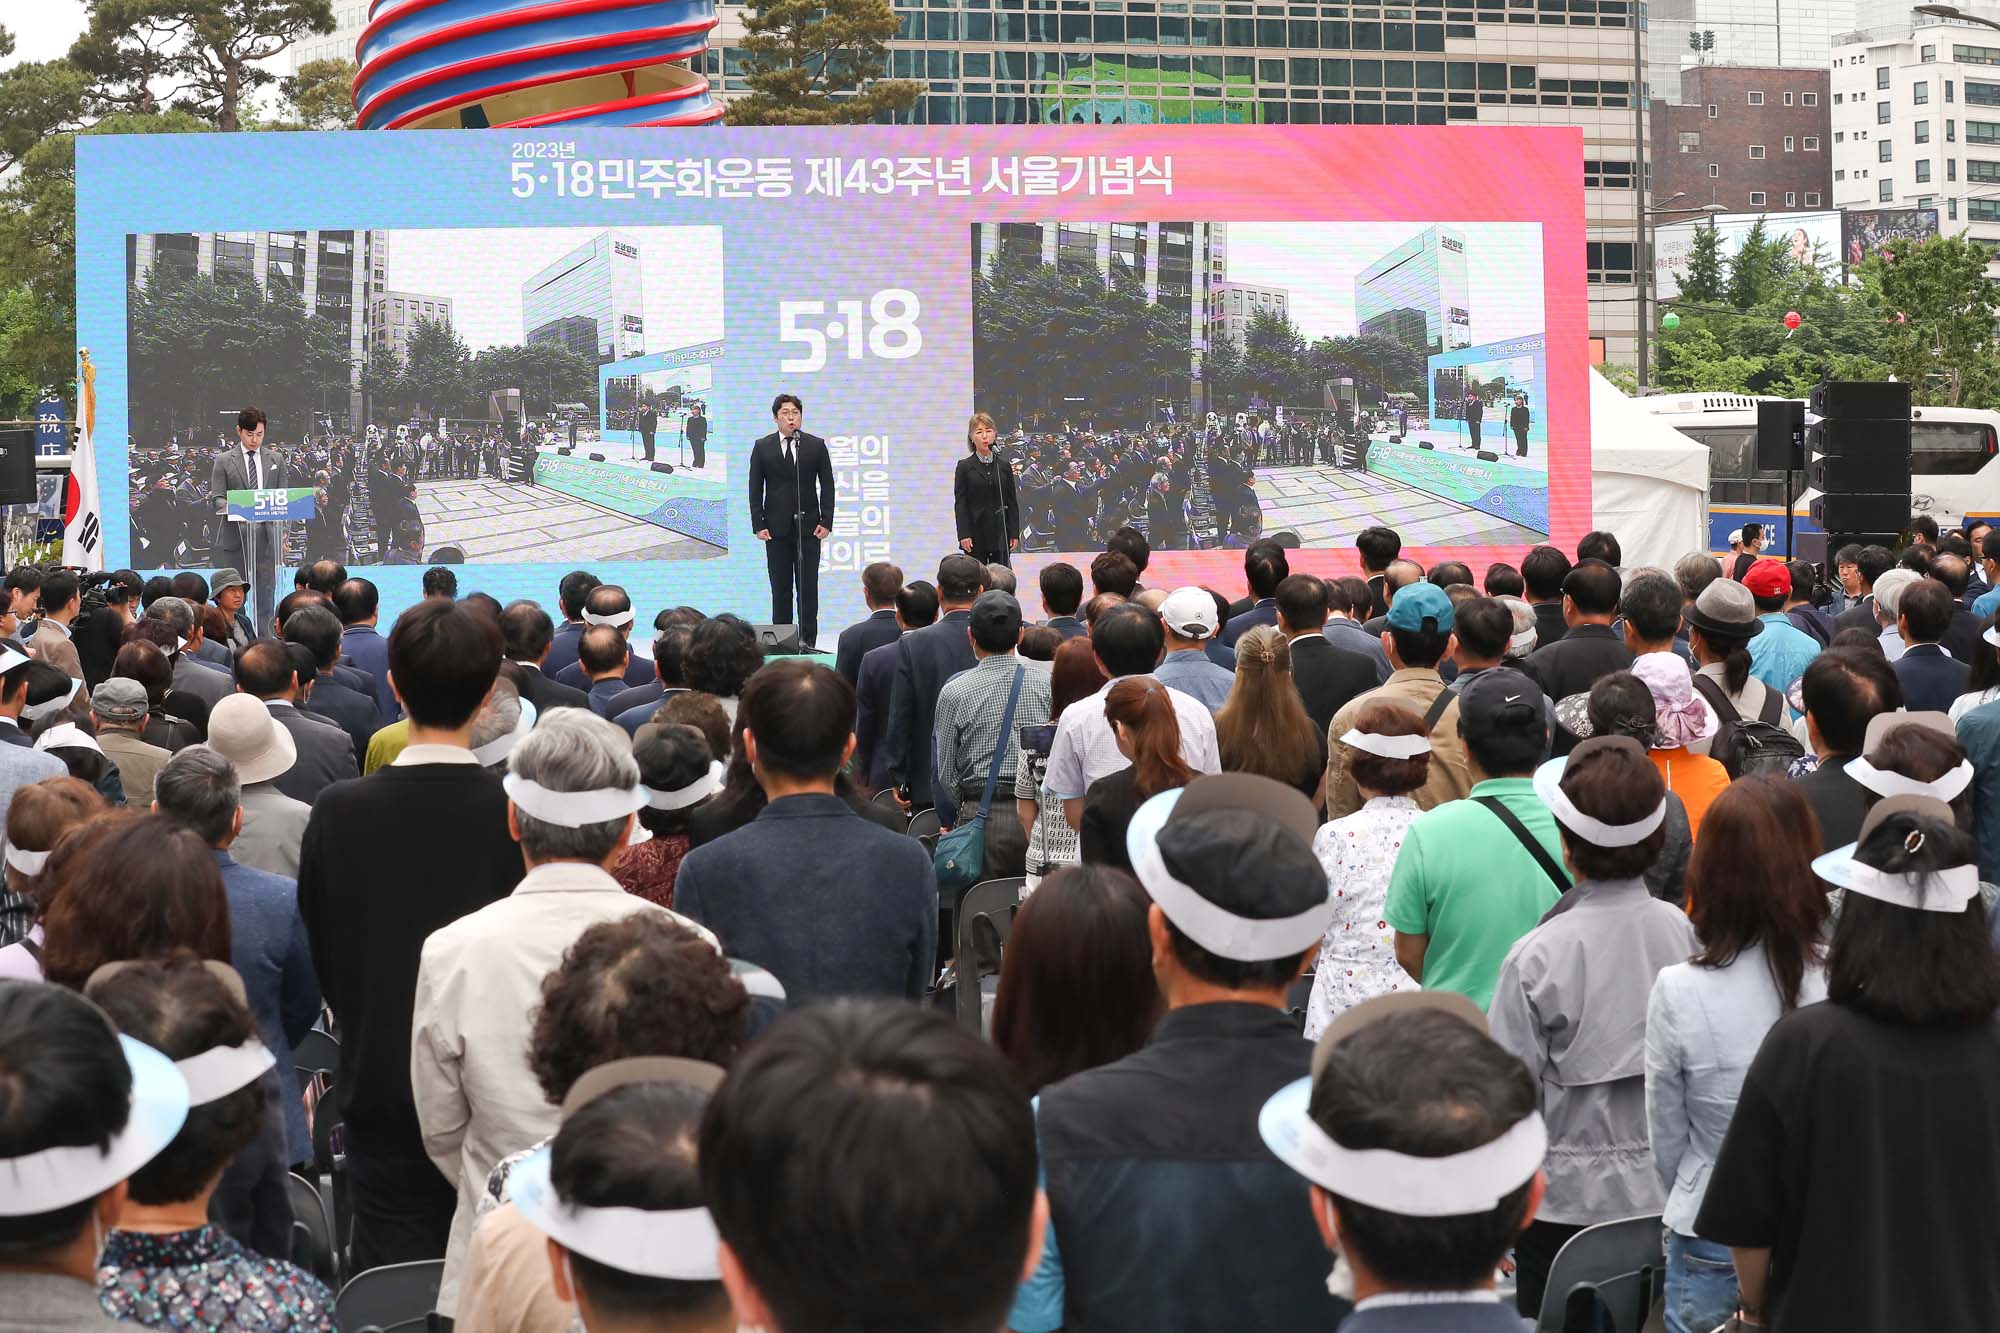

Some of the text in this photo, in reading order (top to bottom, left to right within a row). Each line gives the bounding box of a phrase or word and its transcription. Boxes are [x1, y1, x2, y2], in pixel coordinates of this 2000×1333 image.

[512, 141, 576, 159] 2023년
[511, 155, 1174, 199] 5·18민주화운동 제43주년 서울기념식
[780, 288, 923, 373] 5·18
[828, 435, 890, 466] 월의
[254, 488, 288, 510] 5·18
[833, 470, 890, 501] 신을
[833, 506, 891, 537] 늘의
